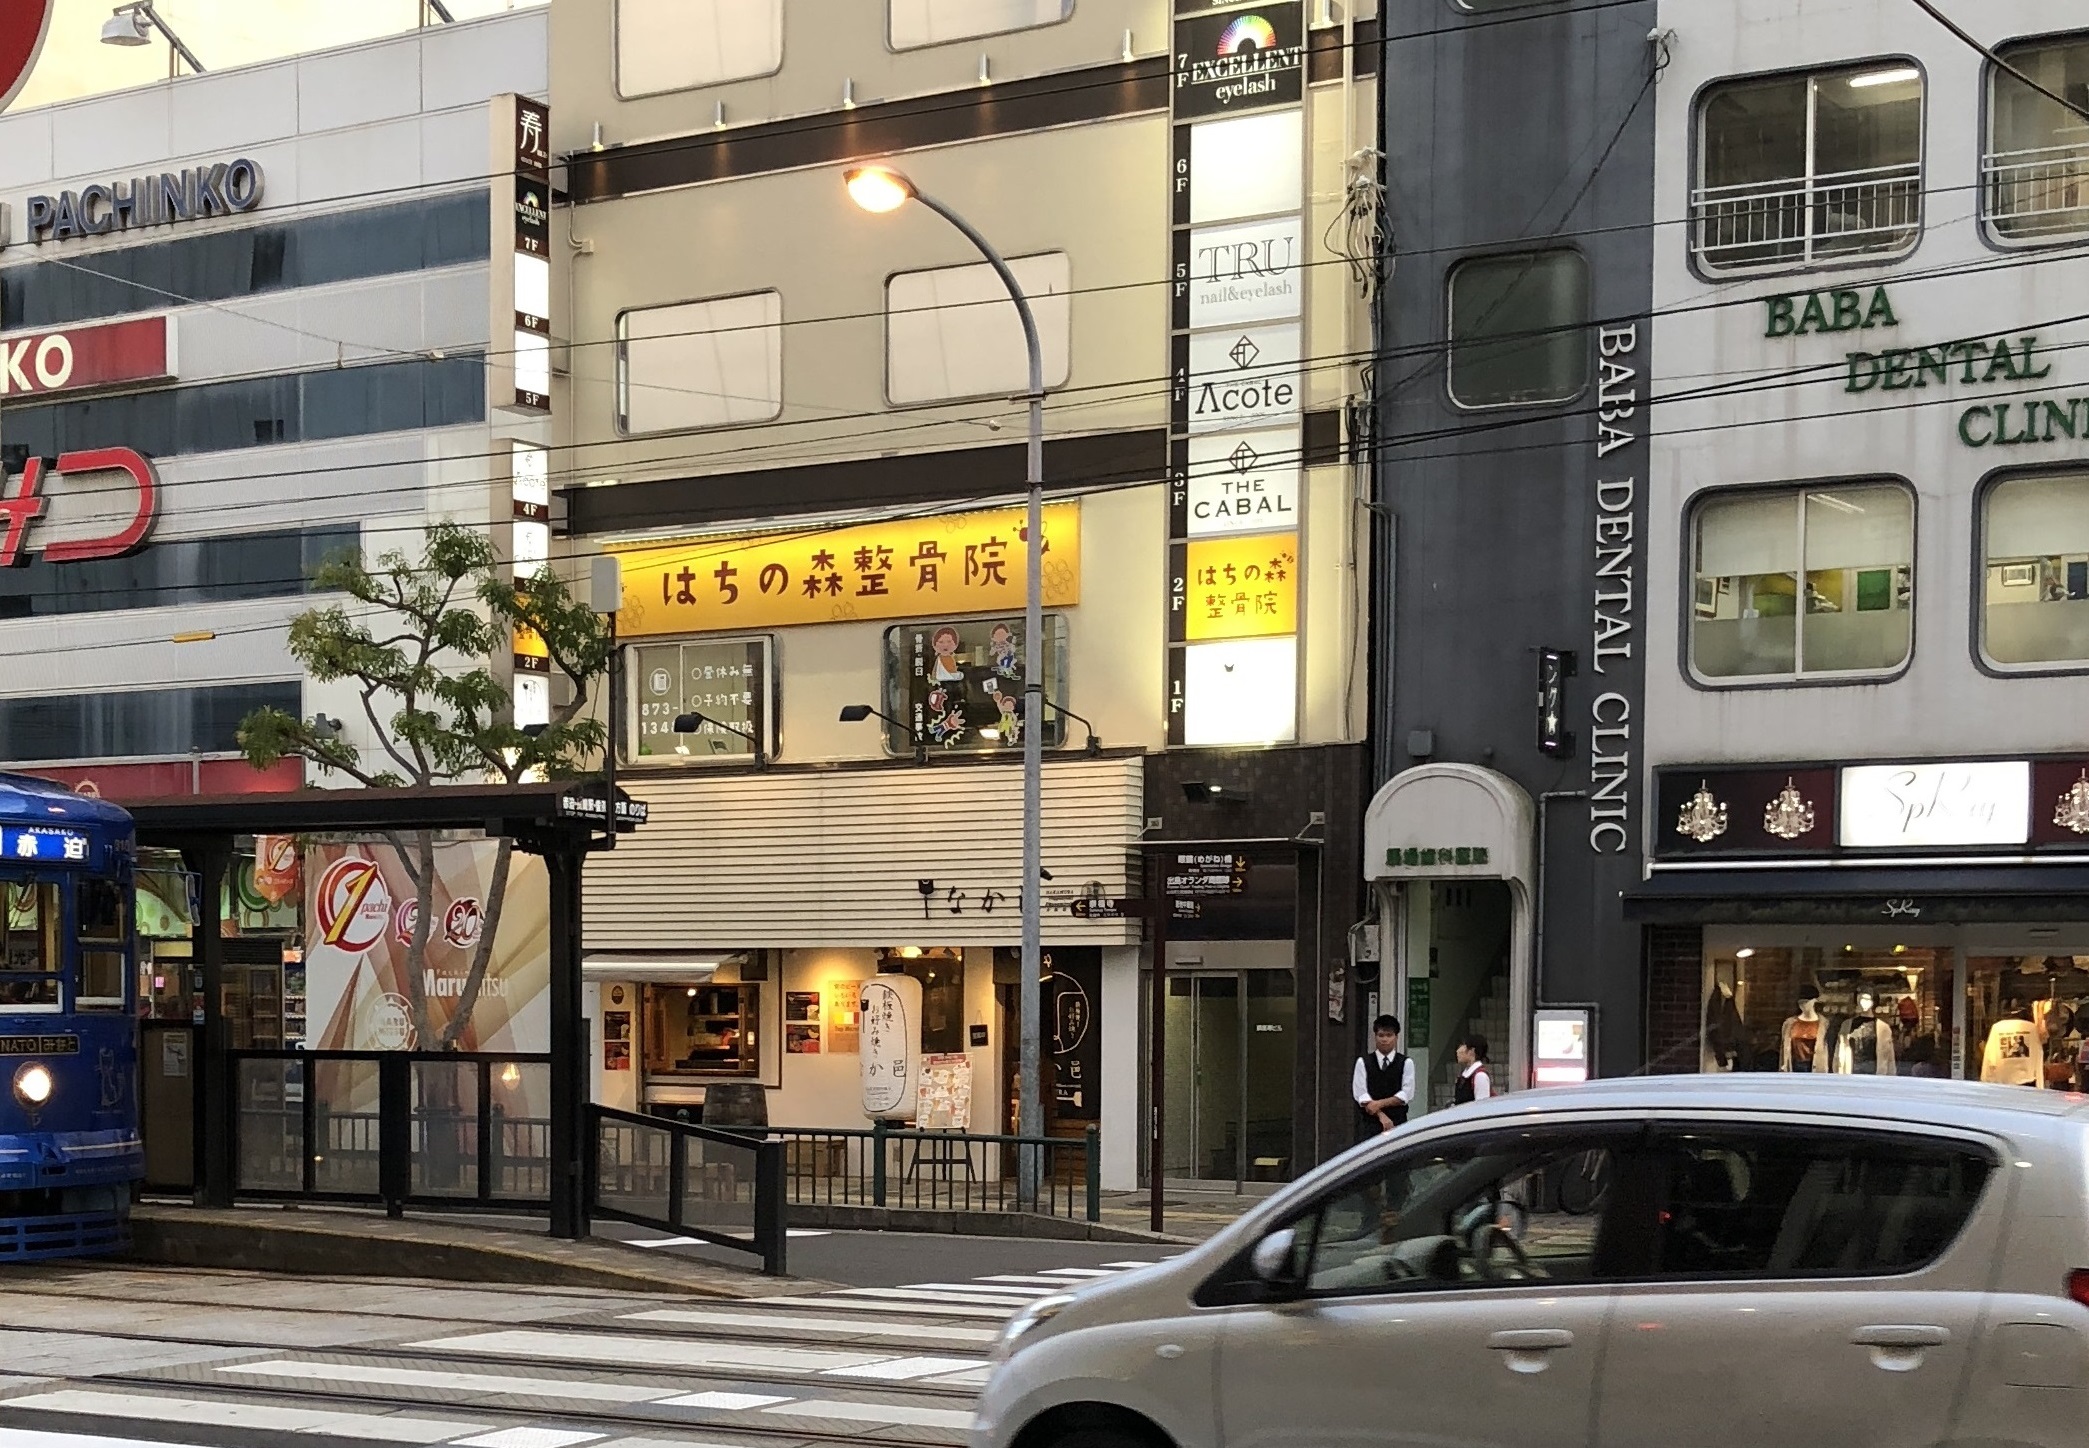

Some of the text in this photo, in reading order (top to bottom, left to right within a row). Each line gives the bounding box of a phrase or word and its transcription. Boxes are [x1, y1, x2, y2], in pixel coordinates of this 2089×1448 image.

[1176, 53, 1190, 88] 7F
[1191, 45, 1302, 82] EXCELLENT
[1215, 73, 1276, 104] eyelash
[519, 109, 543, 154] 寿
[1175, 158, 1188, 193] 6F
[27, 158, 265, 244] PACHINKO
[524, 237, 539, 251] 7F
[1198, 236, 1294, 284] TRU
[1175, 262, 1188, 297] 5F
[1200, 279, 1293, 305] nail&eyelash
[524, 314, 539, 329] 6F
[1765, 285, 1899, 338] BABA
[0, 333, 74, 394] KO
[1844, 336, 2052, 393] DENTAL
[525, 392, 540, 406] 5F
[1221, 479, 1265, 495] THE
[522, 503, 538, 516] 4F
[1194, 495, 1292, 519] CABAL
[663, 535, 1008, 606] はちの森整骨院
[1197, 557, 1287, 586] はちの森
[1171, 577, 1185, 611] 2F
[1589, 323, 1637, 854] BABA DENTAL CLINIC
[1205, 590, 1278, 619] 整骨院
[524, 656, 539, 669] 2F
[703, 691, 753, 708] 予約不要
[1170, 680, 1184, 713] 1F
[641, 721, 676, 735] 134
[16, 833, 85, 859] 赤迫
[947, 885, 1024, 915] なか
[422, 968, 509, 998] Maruitsu
